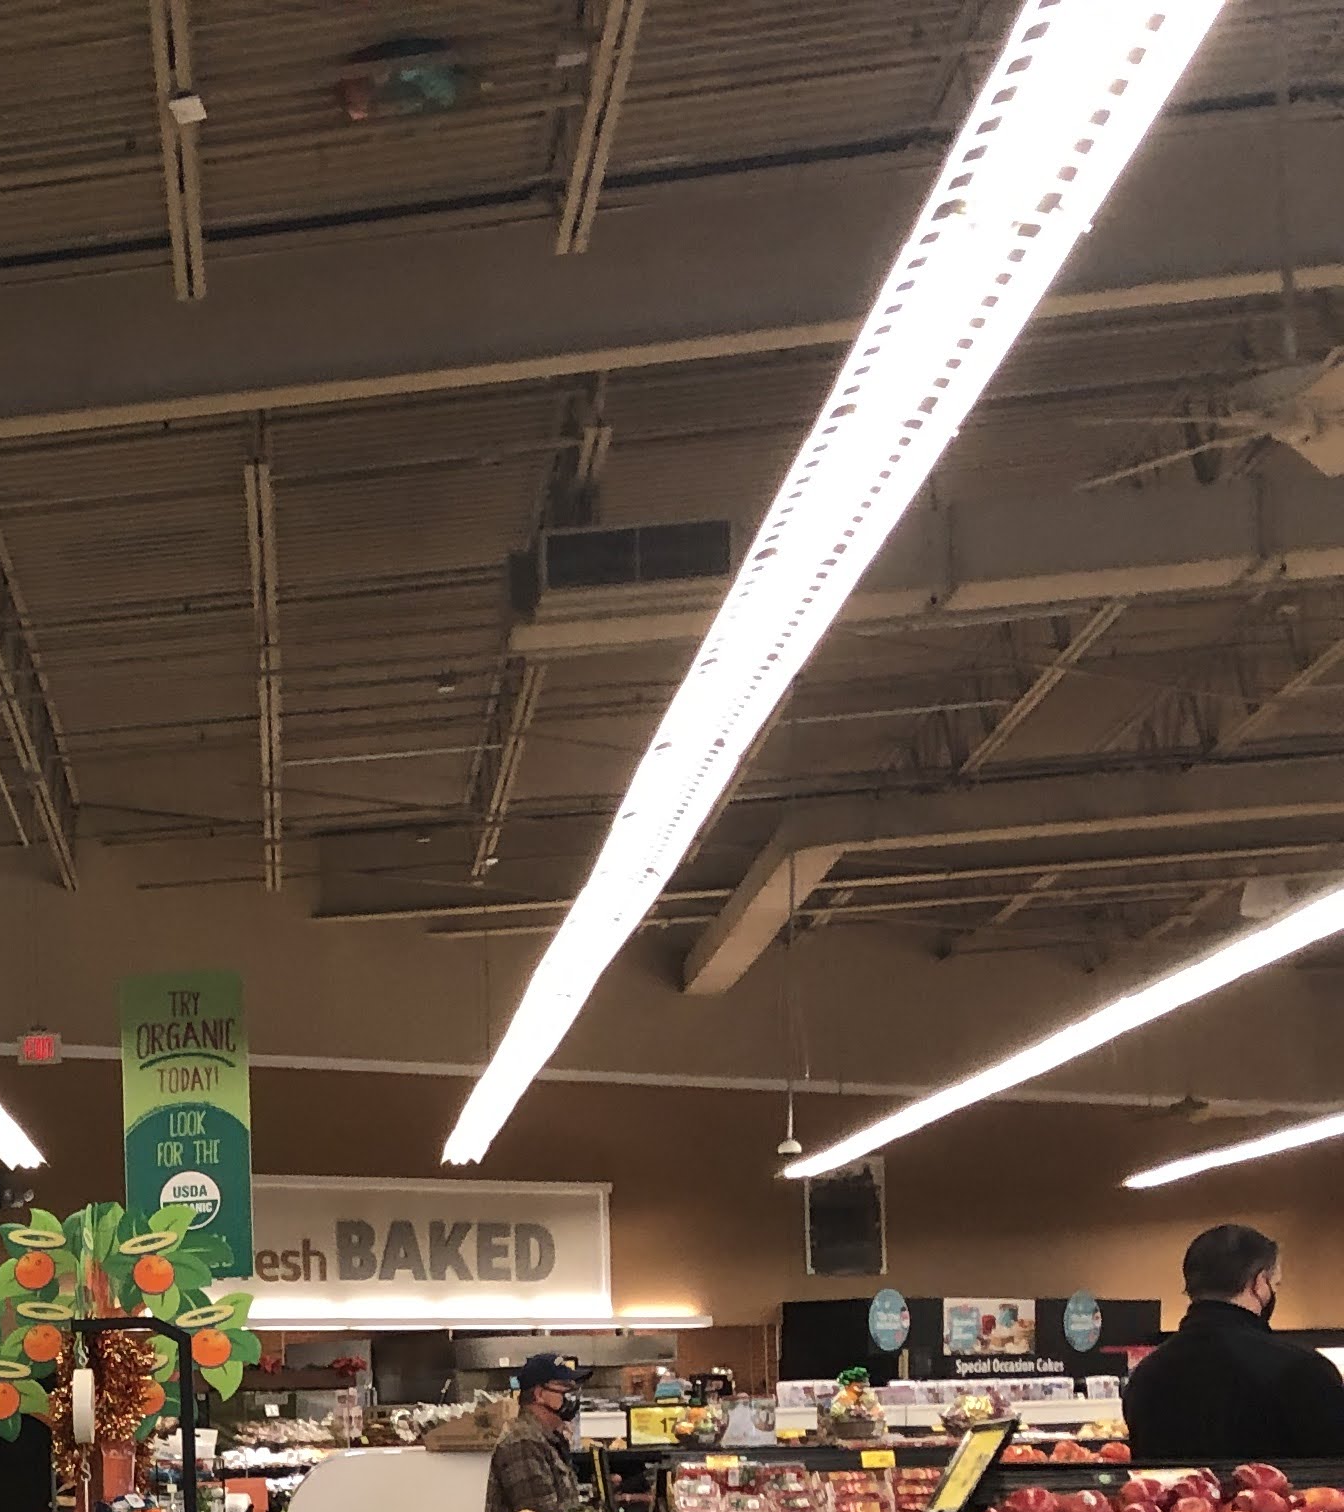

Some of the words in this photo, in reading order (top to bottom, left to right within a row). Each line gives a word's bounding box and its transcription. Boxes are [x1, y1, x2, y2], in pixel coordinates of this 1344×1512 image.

[167, 991, 200, 1018] TRY
[136, 1018, 236, 1060] ORGANIC
[157, 1067, 219, 1094] TODAY!
[169, 1110, 206, 1138] LOOK
[157, 1142, 183, 1168] FOR
[193, 1139, 219, 1165] THE
[173, 1185, 208, 1198] USDA
[255, 1238, 327, 1282] esh
[336, 1220, 556, 1282] BAKED
[956, 1358, 990, 1376] Special
[992, 1358, 1034, 1374] Occasion
[1036, 1357, 1064, 1373] Cakes
